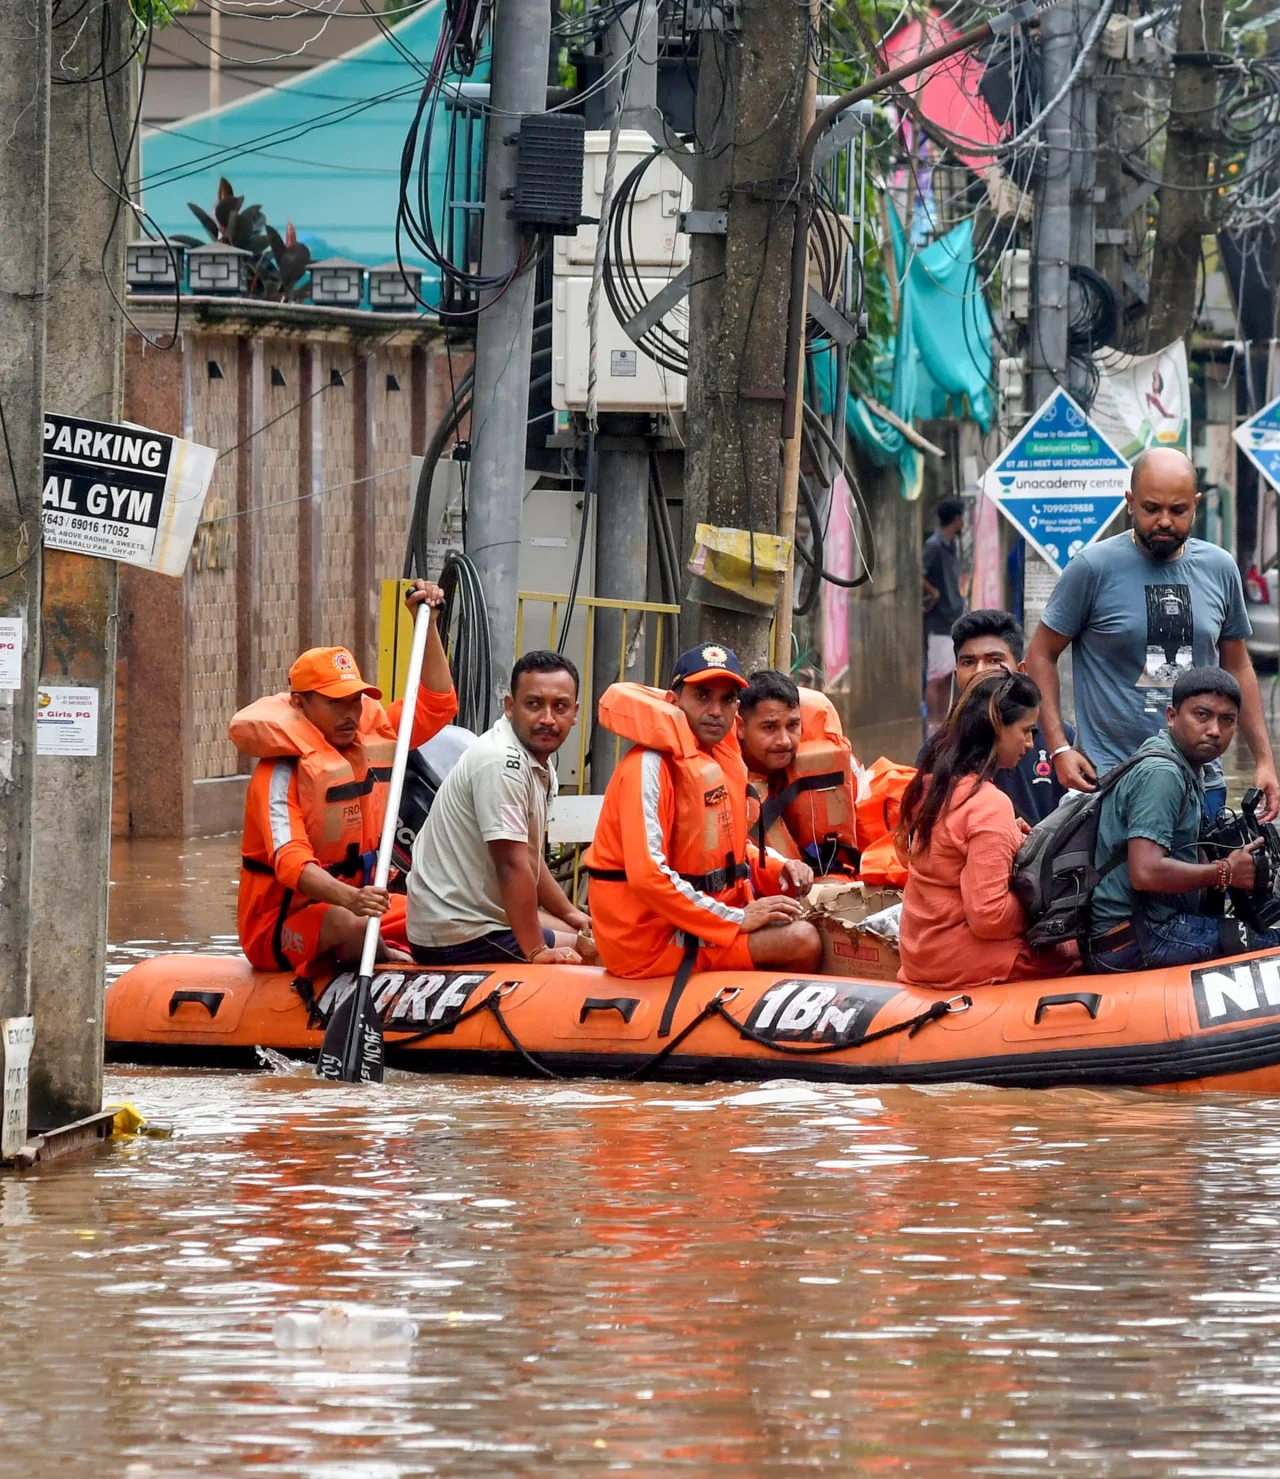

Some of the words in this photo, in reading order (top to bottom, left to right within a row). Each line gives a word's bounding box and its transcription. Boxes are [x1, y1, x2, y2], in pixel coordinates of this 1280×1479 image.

[43, 422, 162, 468] PARKING
[1032, 444, 1070, 453] Admission
[1067, 458, 1117, 467] FOUNDATION
[1016, 477, 1087, 490] unacademy
[1090, 479, 1124, 488] centre
[86, 483, 154, 523] GYM
[71, 518, 99, 532] 69016
[102, 523, 130, 538] 17052
[58, 530, 82, 540] ABOVE
[58, 537, 91, 549] BHARALU
